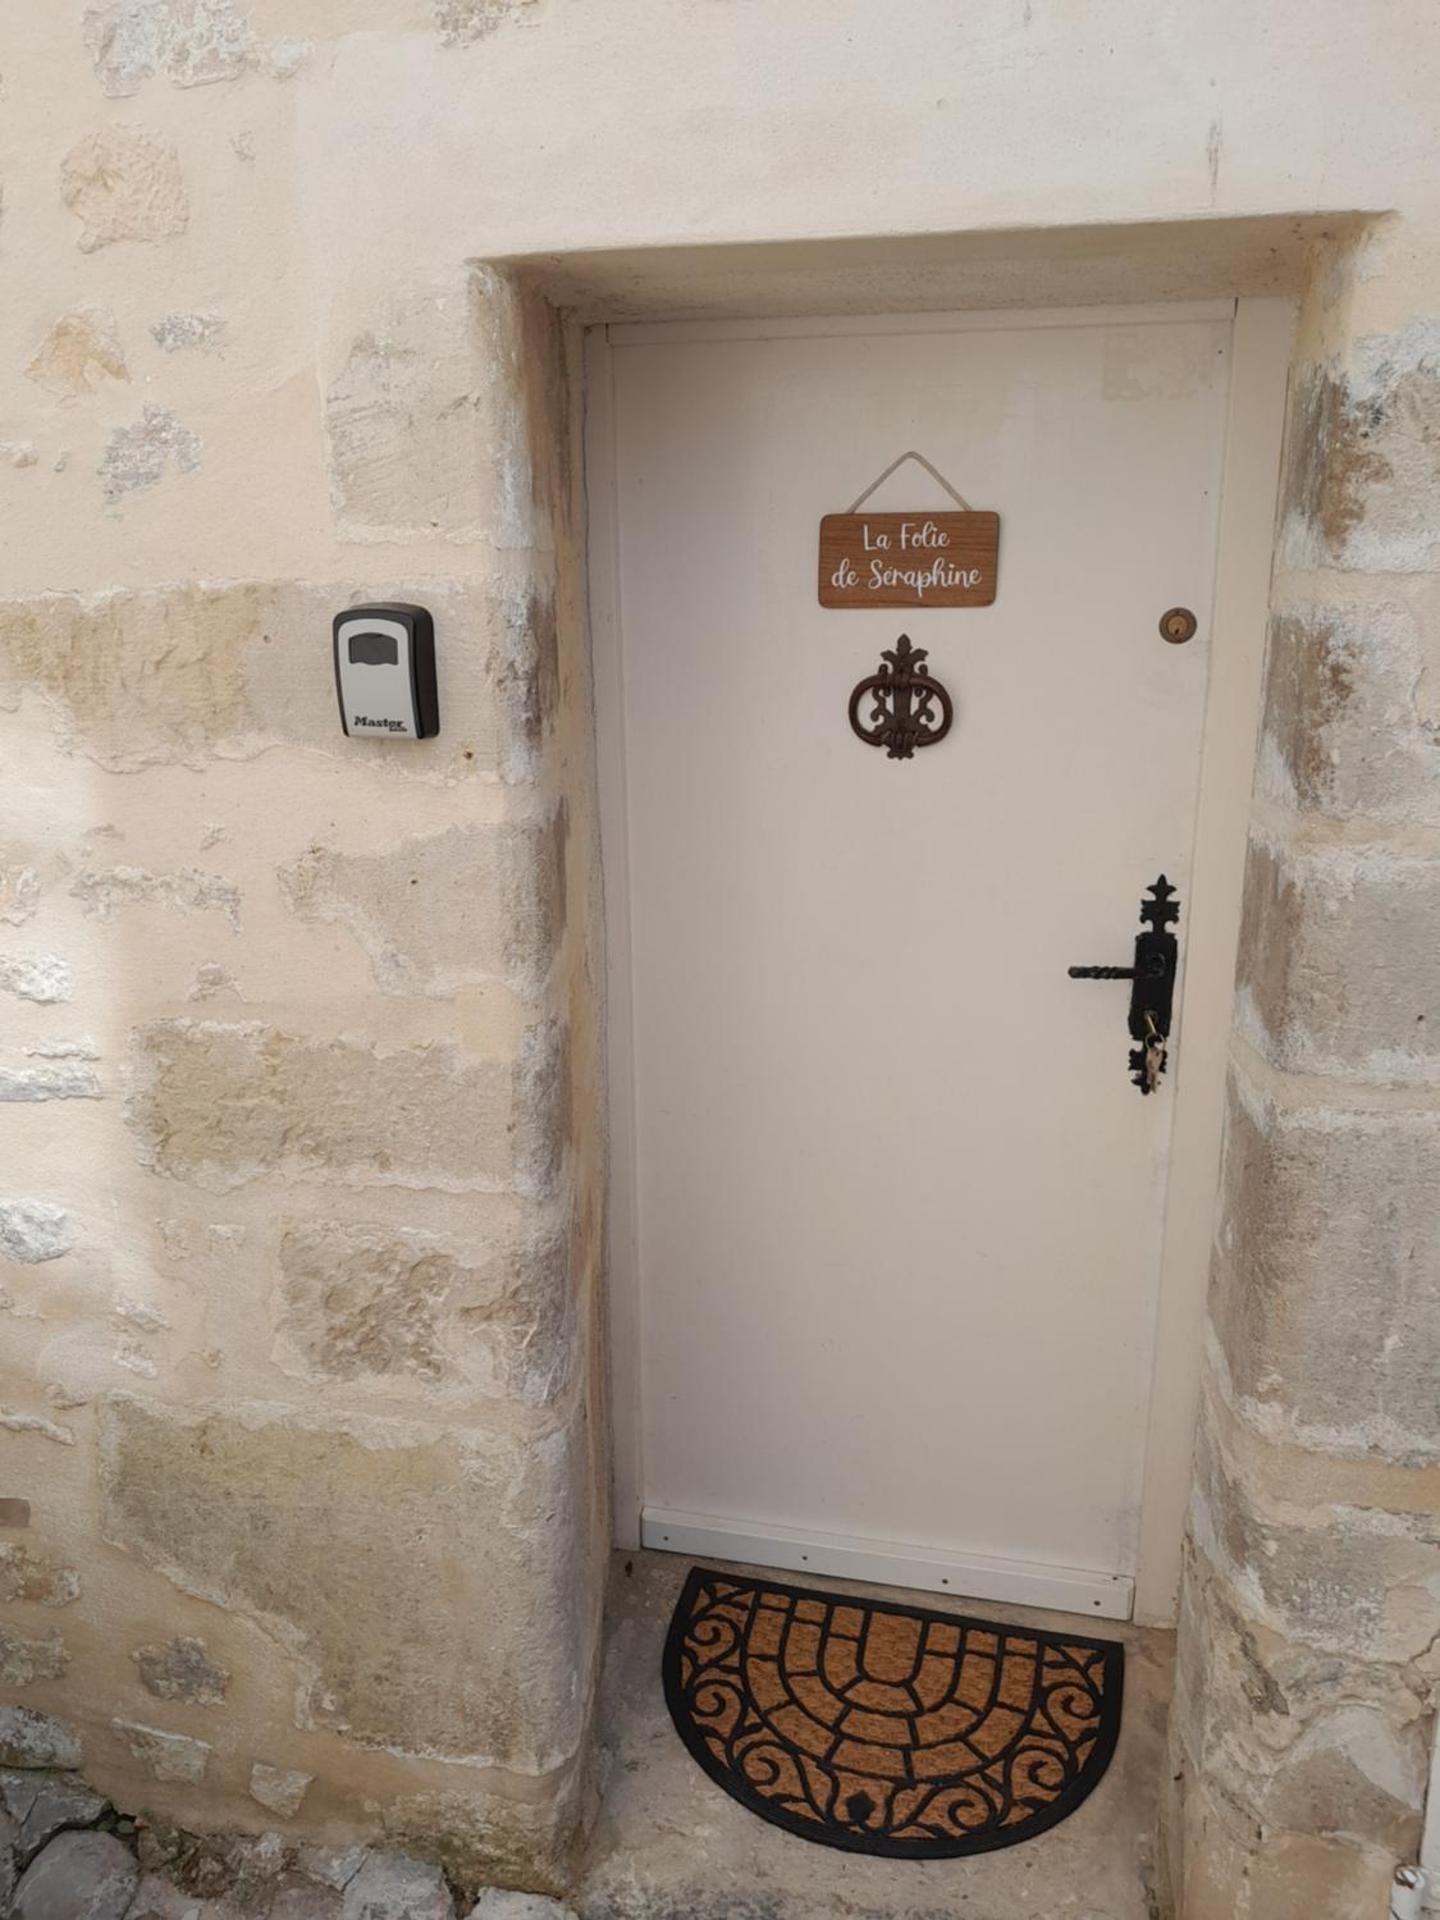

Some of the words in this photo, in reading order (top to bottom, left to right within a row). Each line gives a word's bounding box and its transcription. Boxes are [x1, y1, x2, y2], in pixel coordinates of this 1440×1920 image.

[863, 523, 891, 551] La
[900, 521, 951, 550] Folie
[831, 558, 860, 588] de
[354, 716, 404, 728] Master
